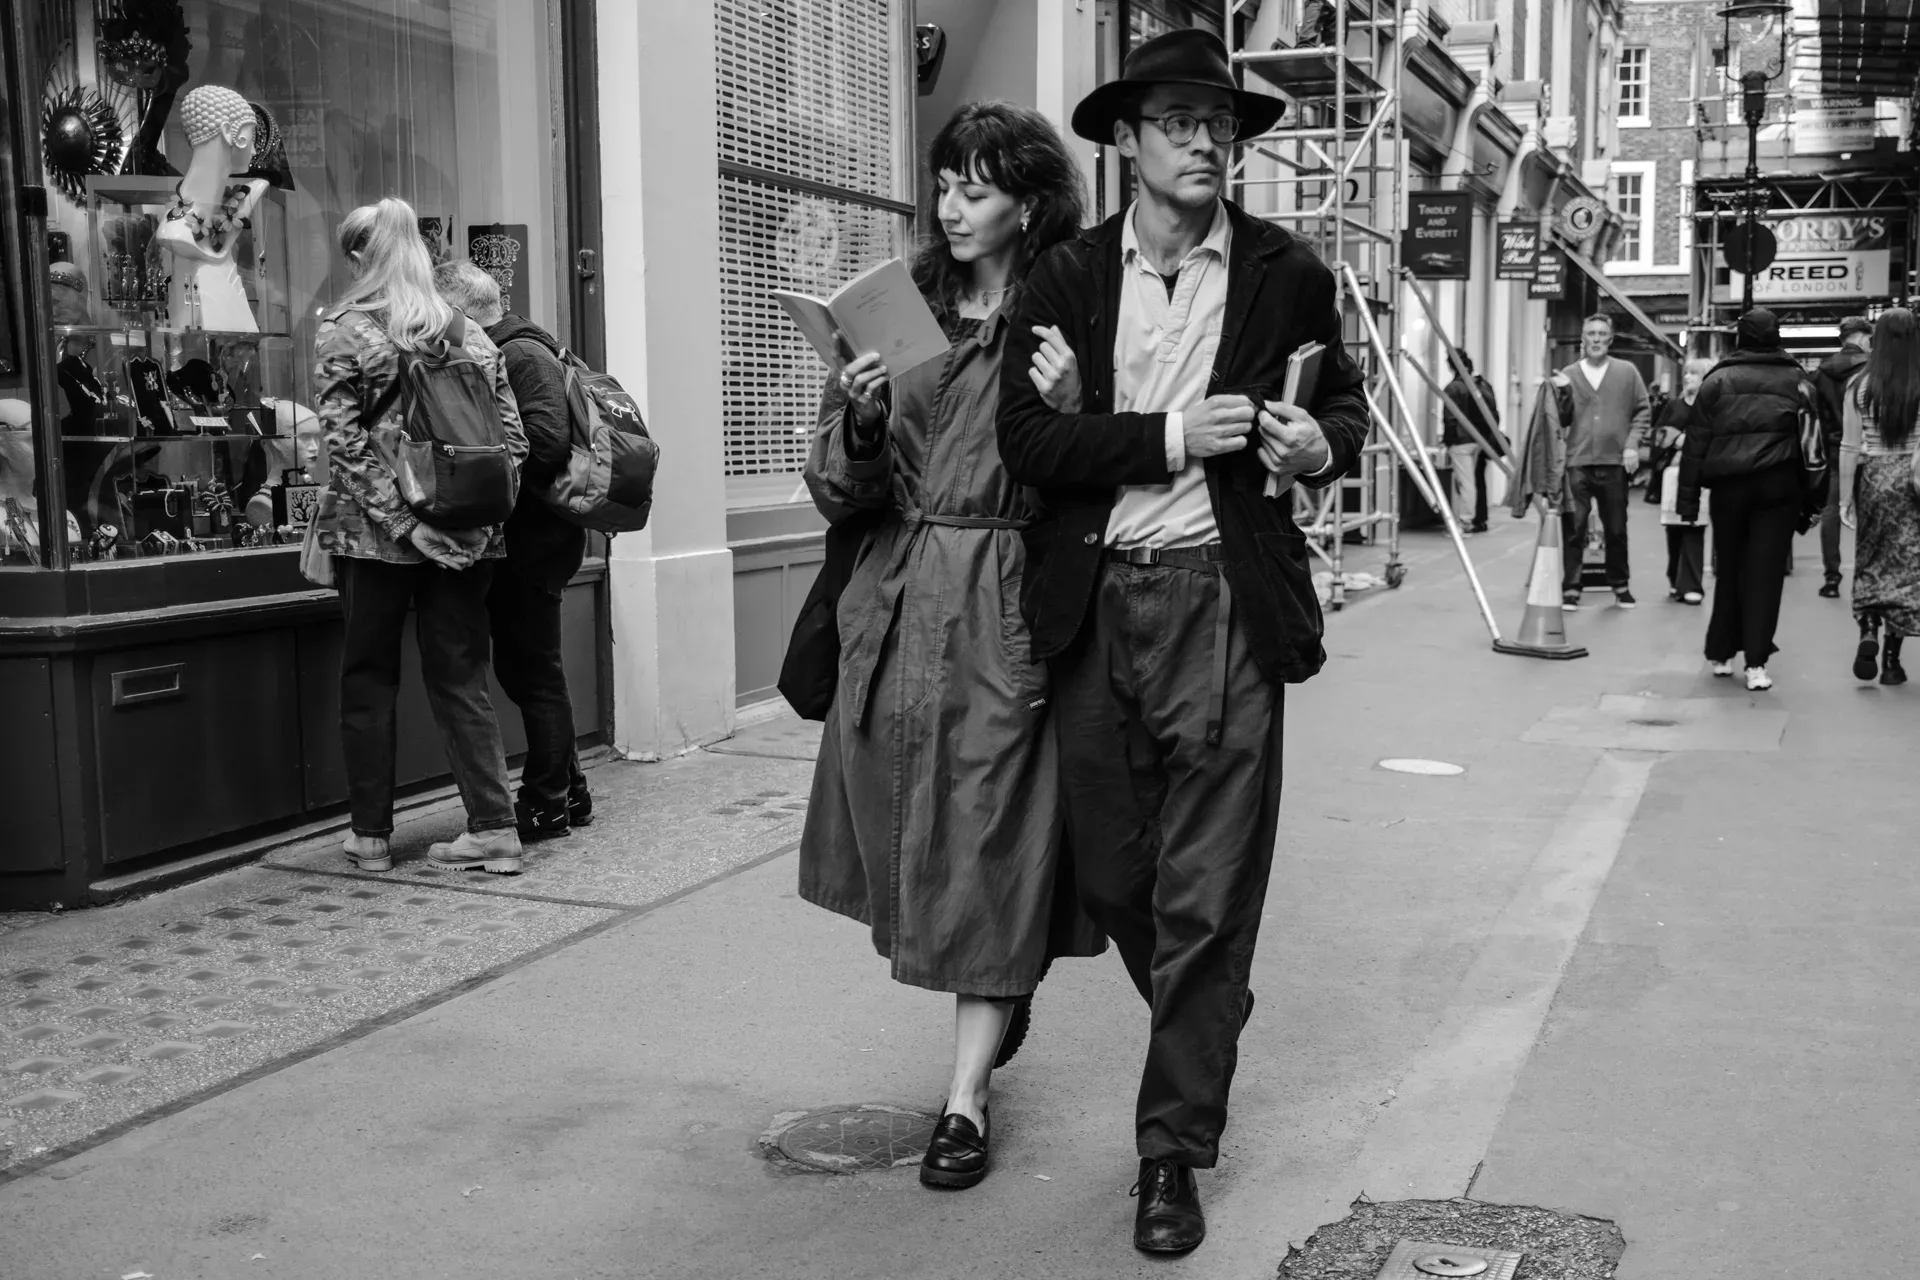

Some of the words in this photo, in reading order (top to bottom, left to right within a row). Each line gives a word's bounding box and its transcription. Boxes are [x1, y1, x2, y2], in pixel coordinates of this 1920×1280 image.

[1810, 98, 1863, 109] WARNING
[1753, 282, 1773, 294] OF
[1781, 281, 1848, 293] LONDON
